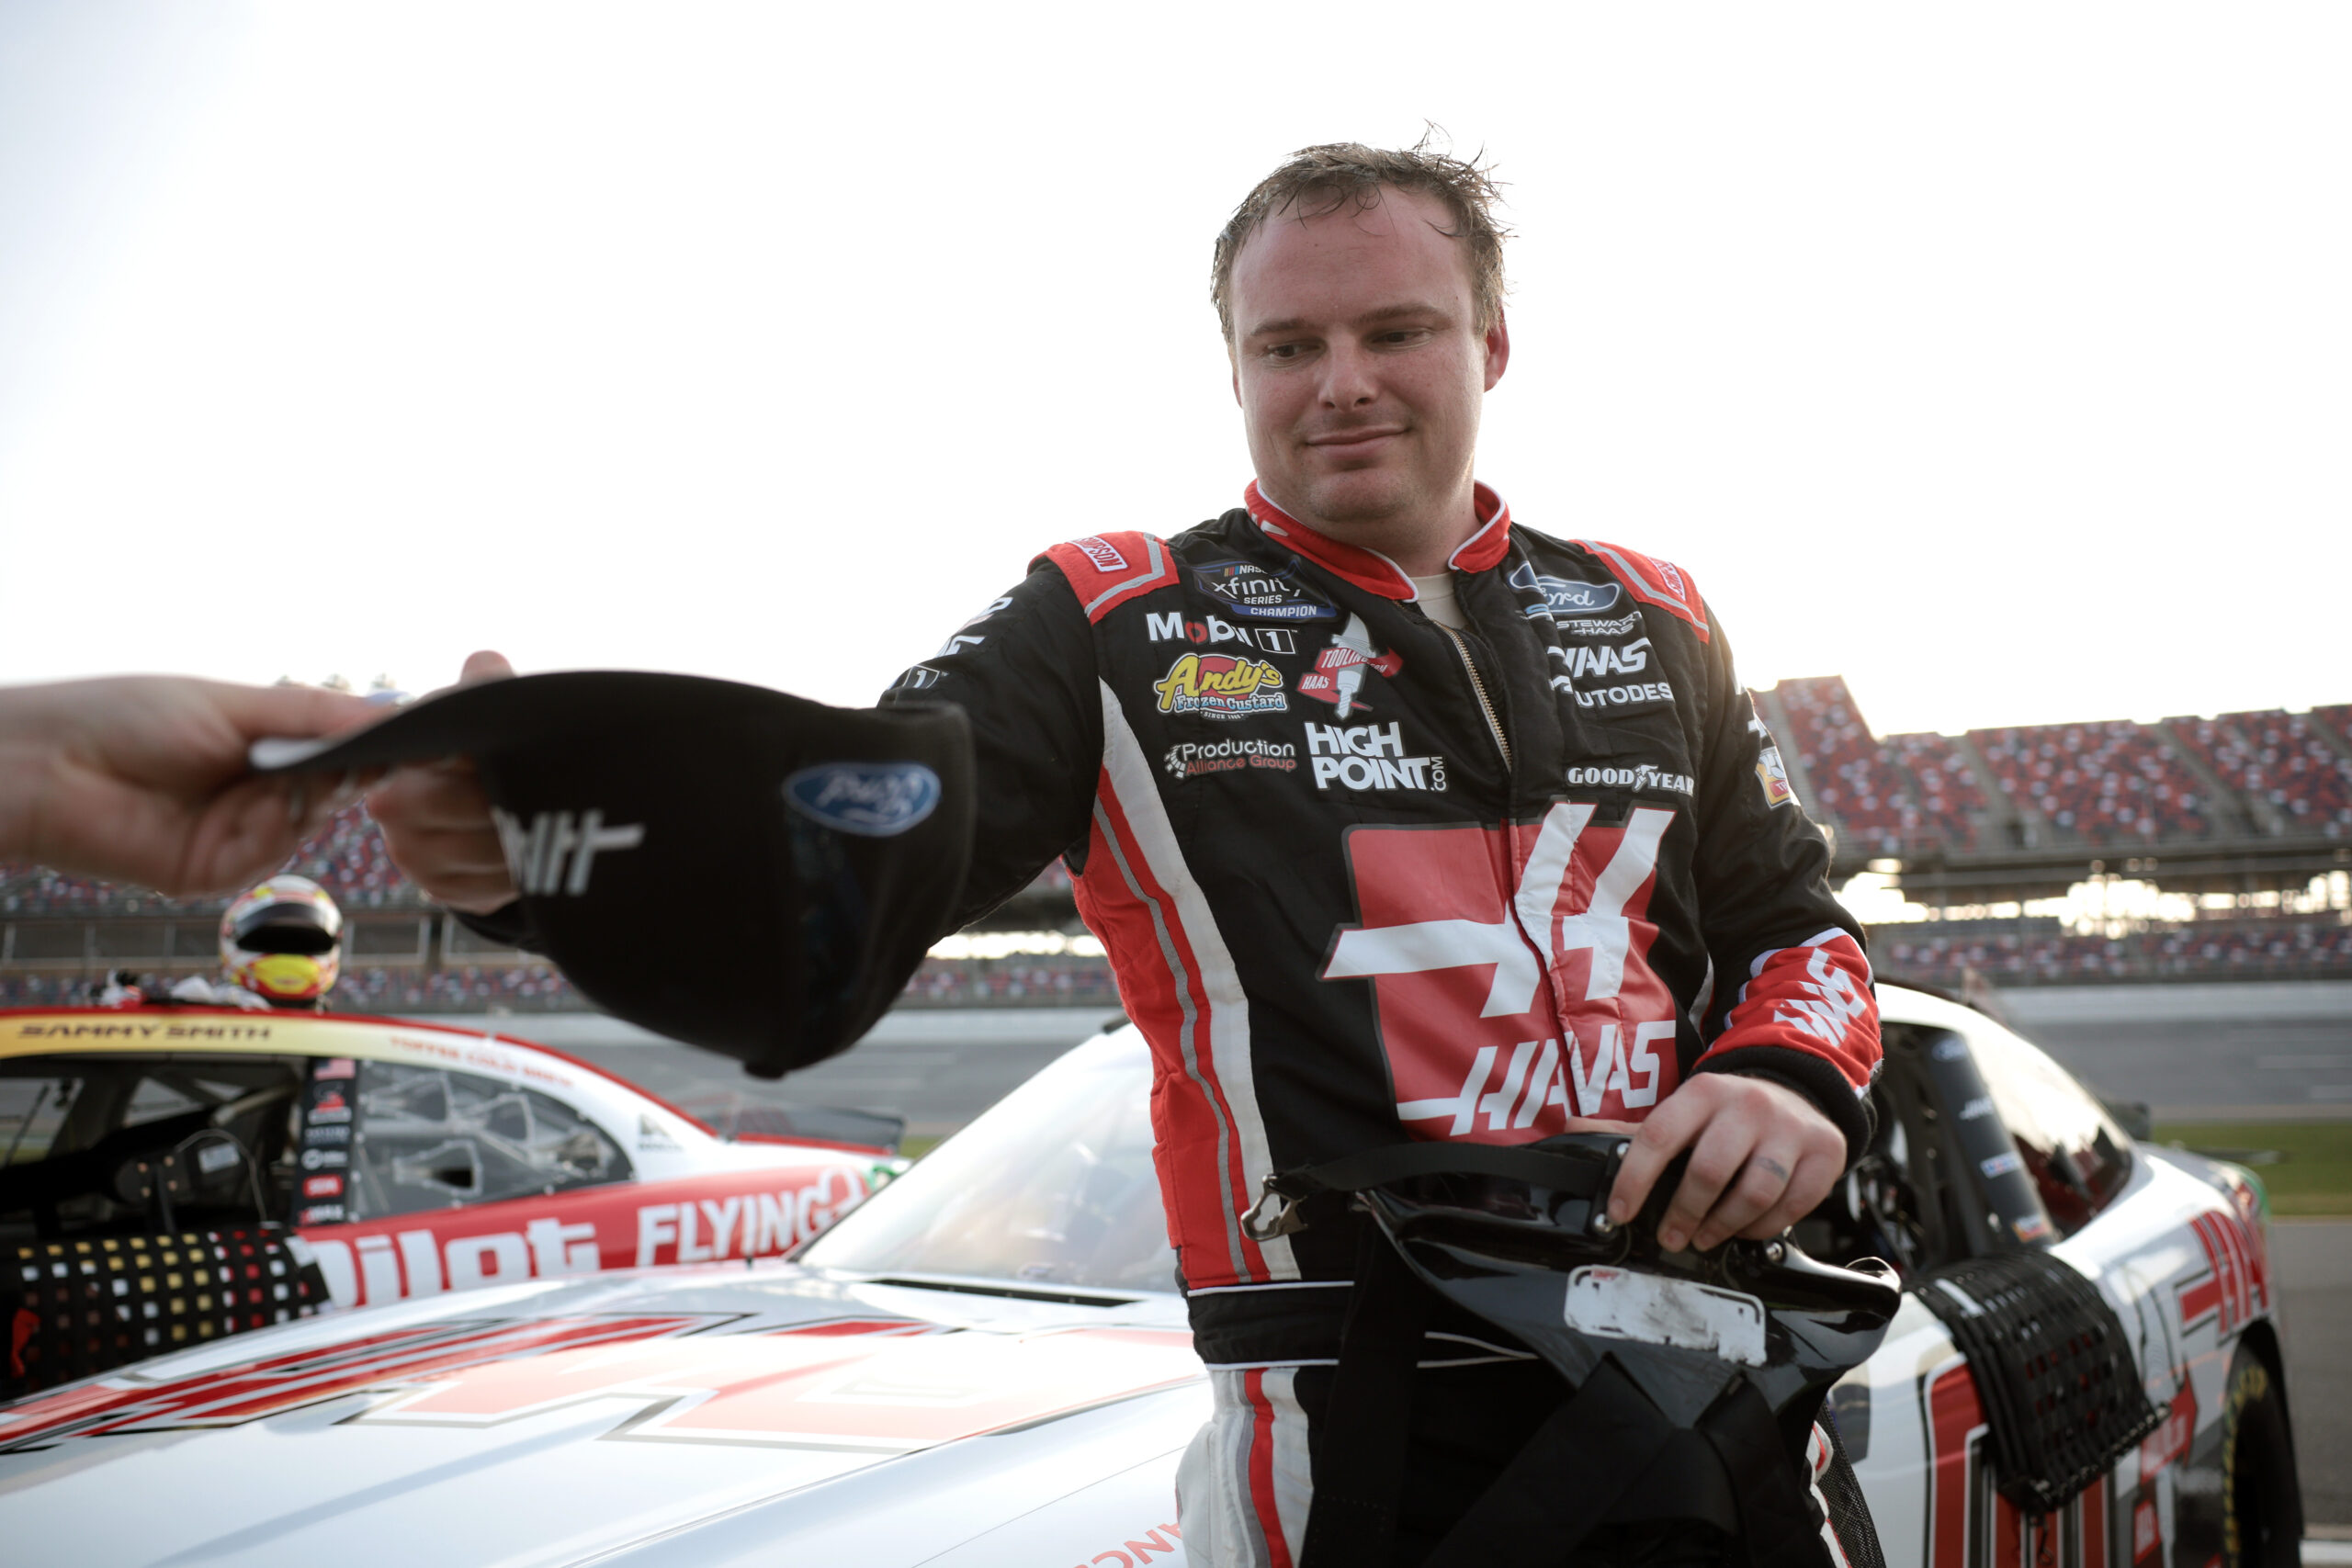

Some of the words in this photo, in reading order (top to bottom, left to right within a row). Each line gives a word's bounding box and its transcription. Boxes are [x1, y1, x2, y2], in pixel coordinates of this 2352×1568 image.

[1239, 565, 1269, 576] NAS
[1243, 594, 1283, 605] SERIES
[1250, 605, 1317, 617] CHAMPION
[1266, 631, 1283, 652] 1
[1157, 655, 1281, 710] Andy's
[1301, 675, 1330, 690] HAAS
[1549, 676, 1675, 706] UTODES
[1175, 694, 1227, 711] Frozen
[1227, 693, 1285, 711] Custard
[1182, 739, 1295, 761] Production
[1305, 721, 1404, 757] HIGH
[1186, 757, 1245, 775] Alliance
[1250, 753, 1297, 771] Group
[1312, 756, 1430, 791] POINT
[19, 1023, 159, 1040] SAMMY
[165, 1023, 272, 1040] SMITH
[1396, 1020, 1677, 1137] HAAS
[636, 1186, 832, 1267] FLYING
